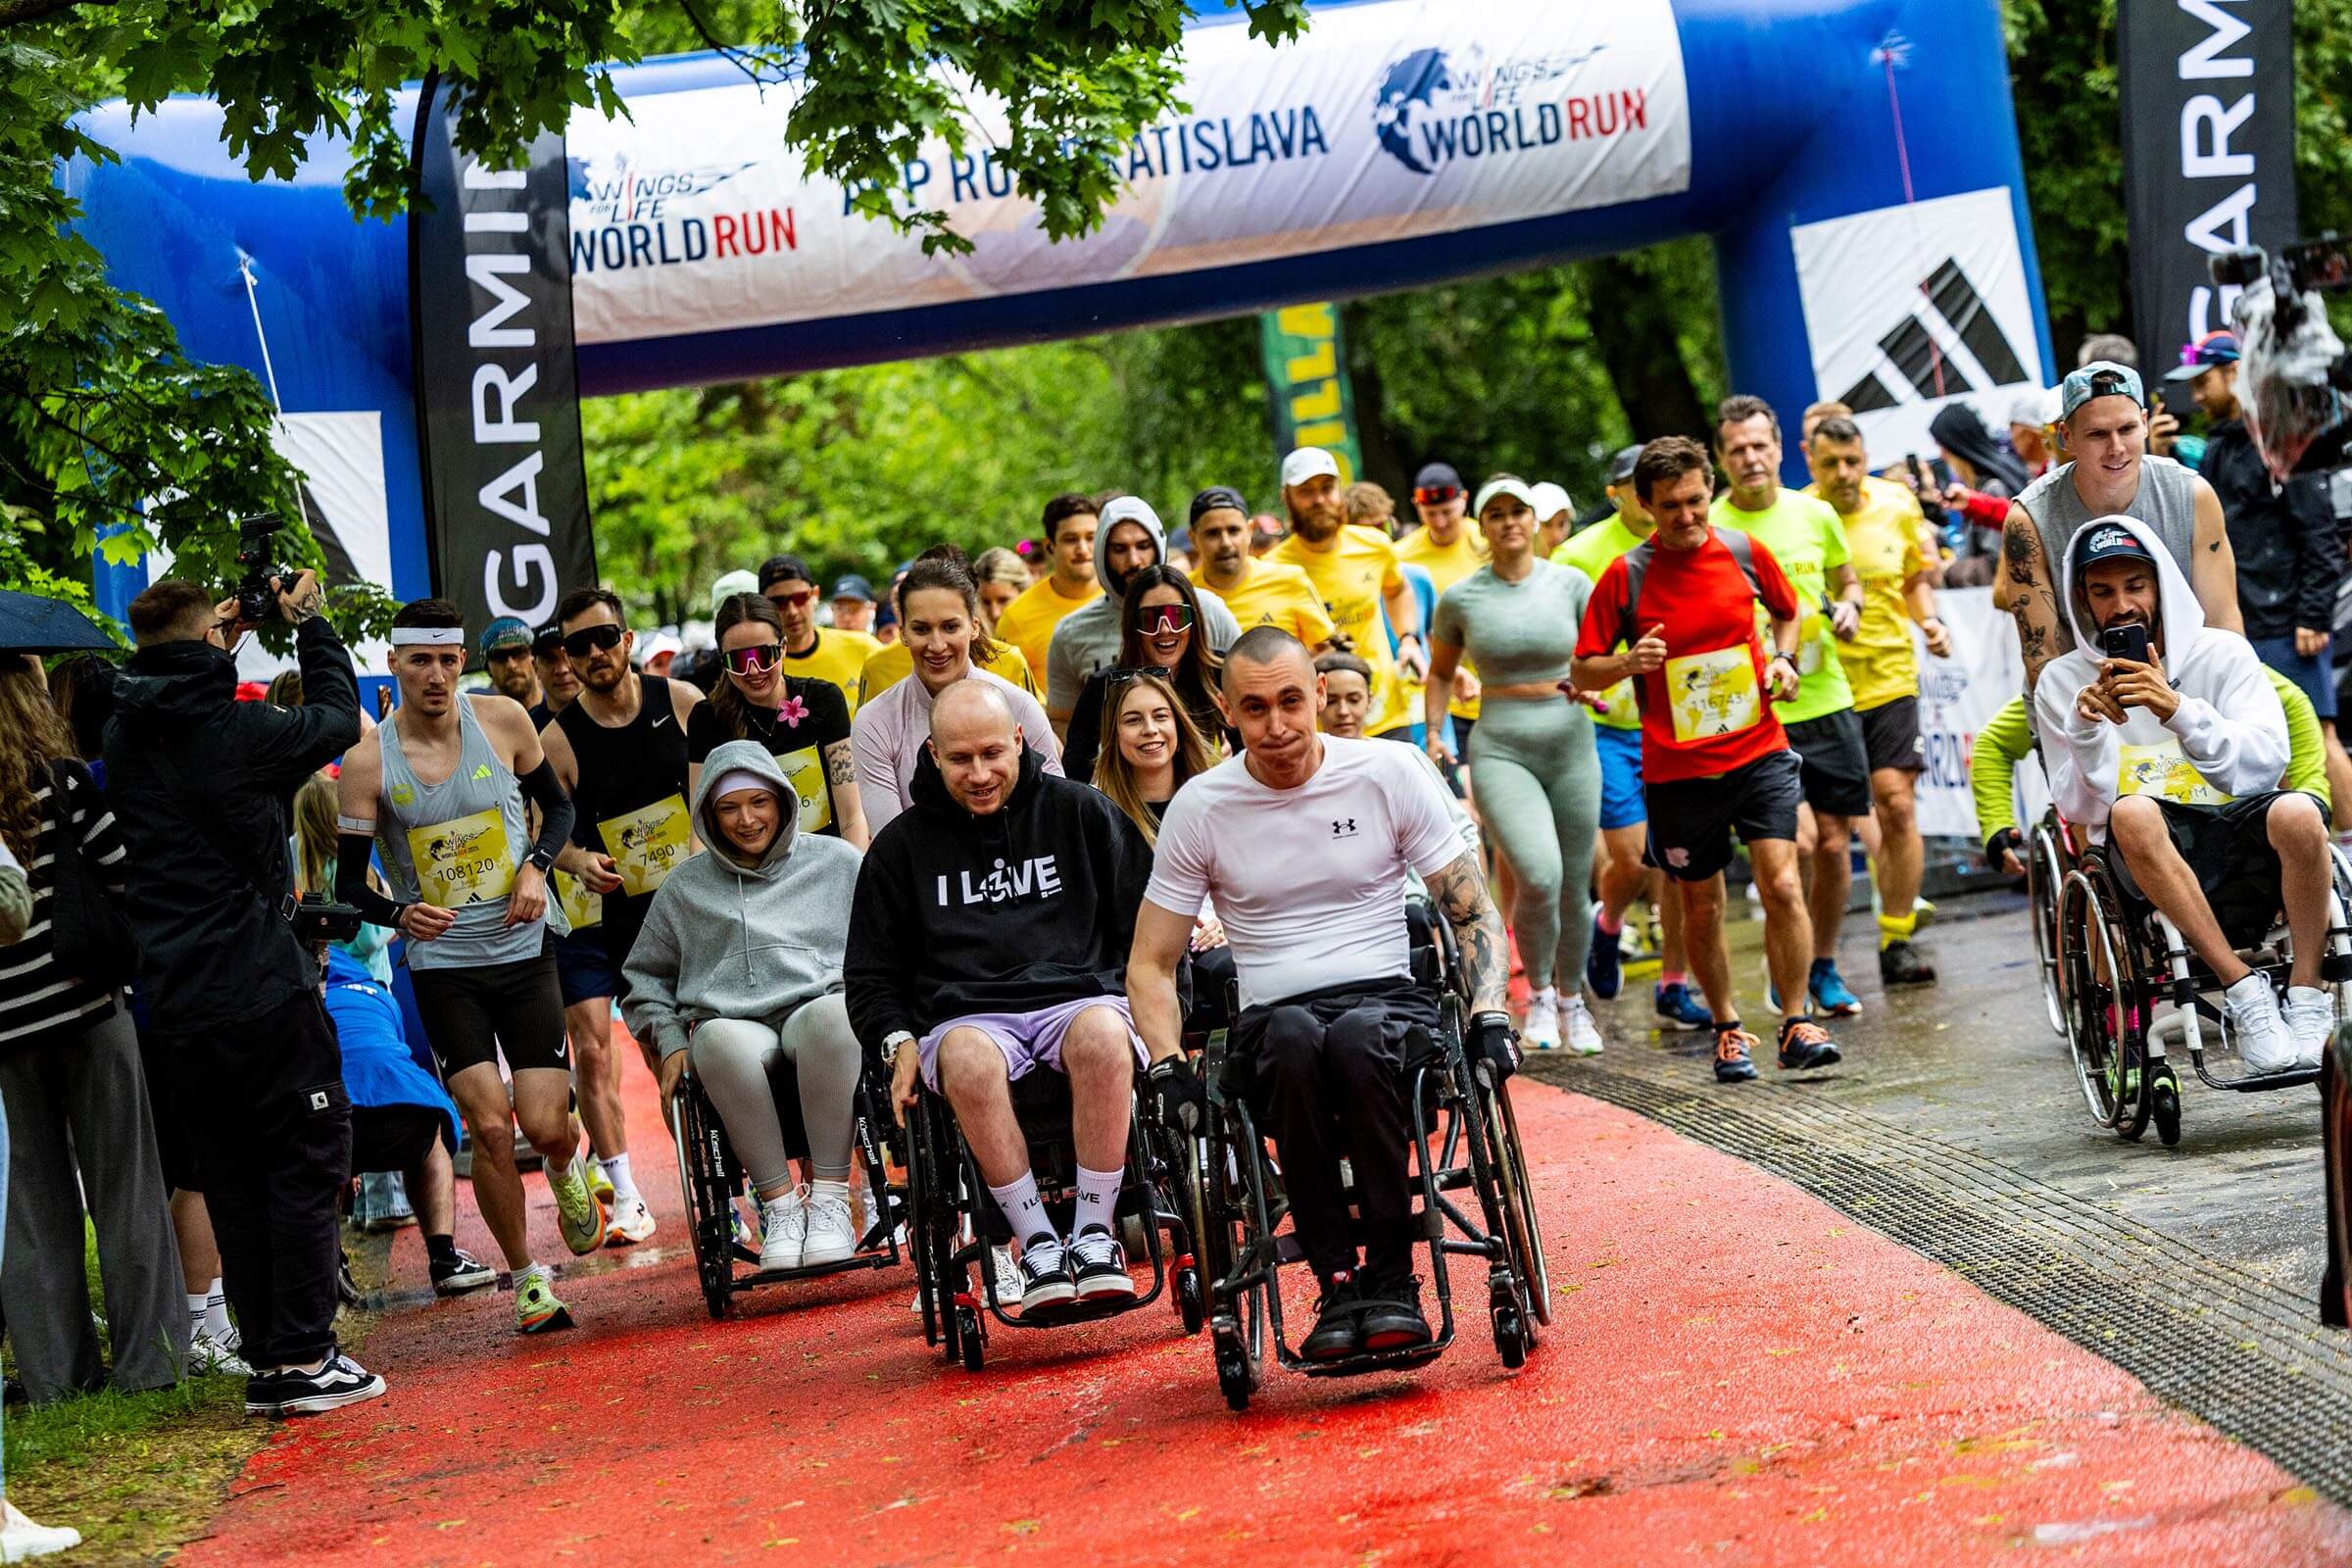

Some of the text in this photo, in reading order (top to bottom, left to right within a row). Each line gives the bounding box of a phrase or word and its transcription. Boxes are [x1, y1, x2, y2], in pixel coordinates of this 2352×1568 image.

[1455, 58, 1549, 90] WINGS
[1422, 87, 1647, 164] WORLD RUN
[1061, 105, 1330, 183] ATISLAVA
[594, 172, 694, 202] WINGS
[612, 196, 668, 223] LIFE
[570, 207, 799, 274] WORLD RUN
[437, 858, 494, 882] 108120
[639, 844, 675, 866] 7490
[938, 875, 949, 906] I
